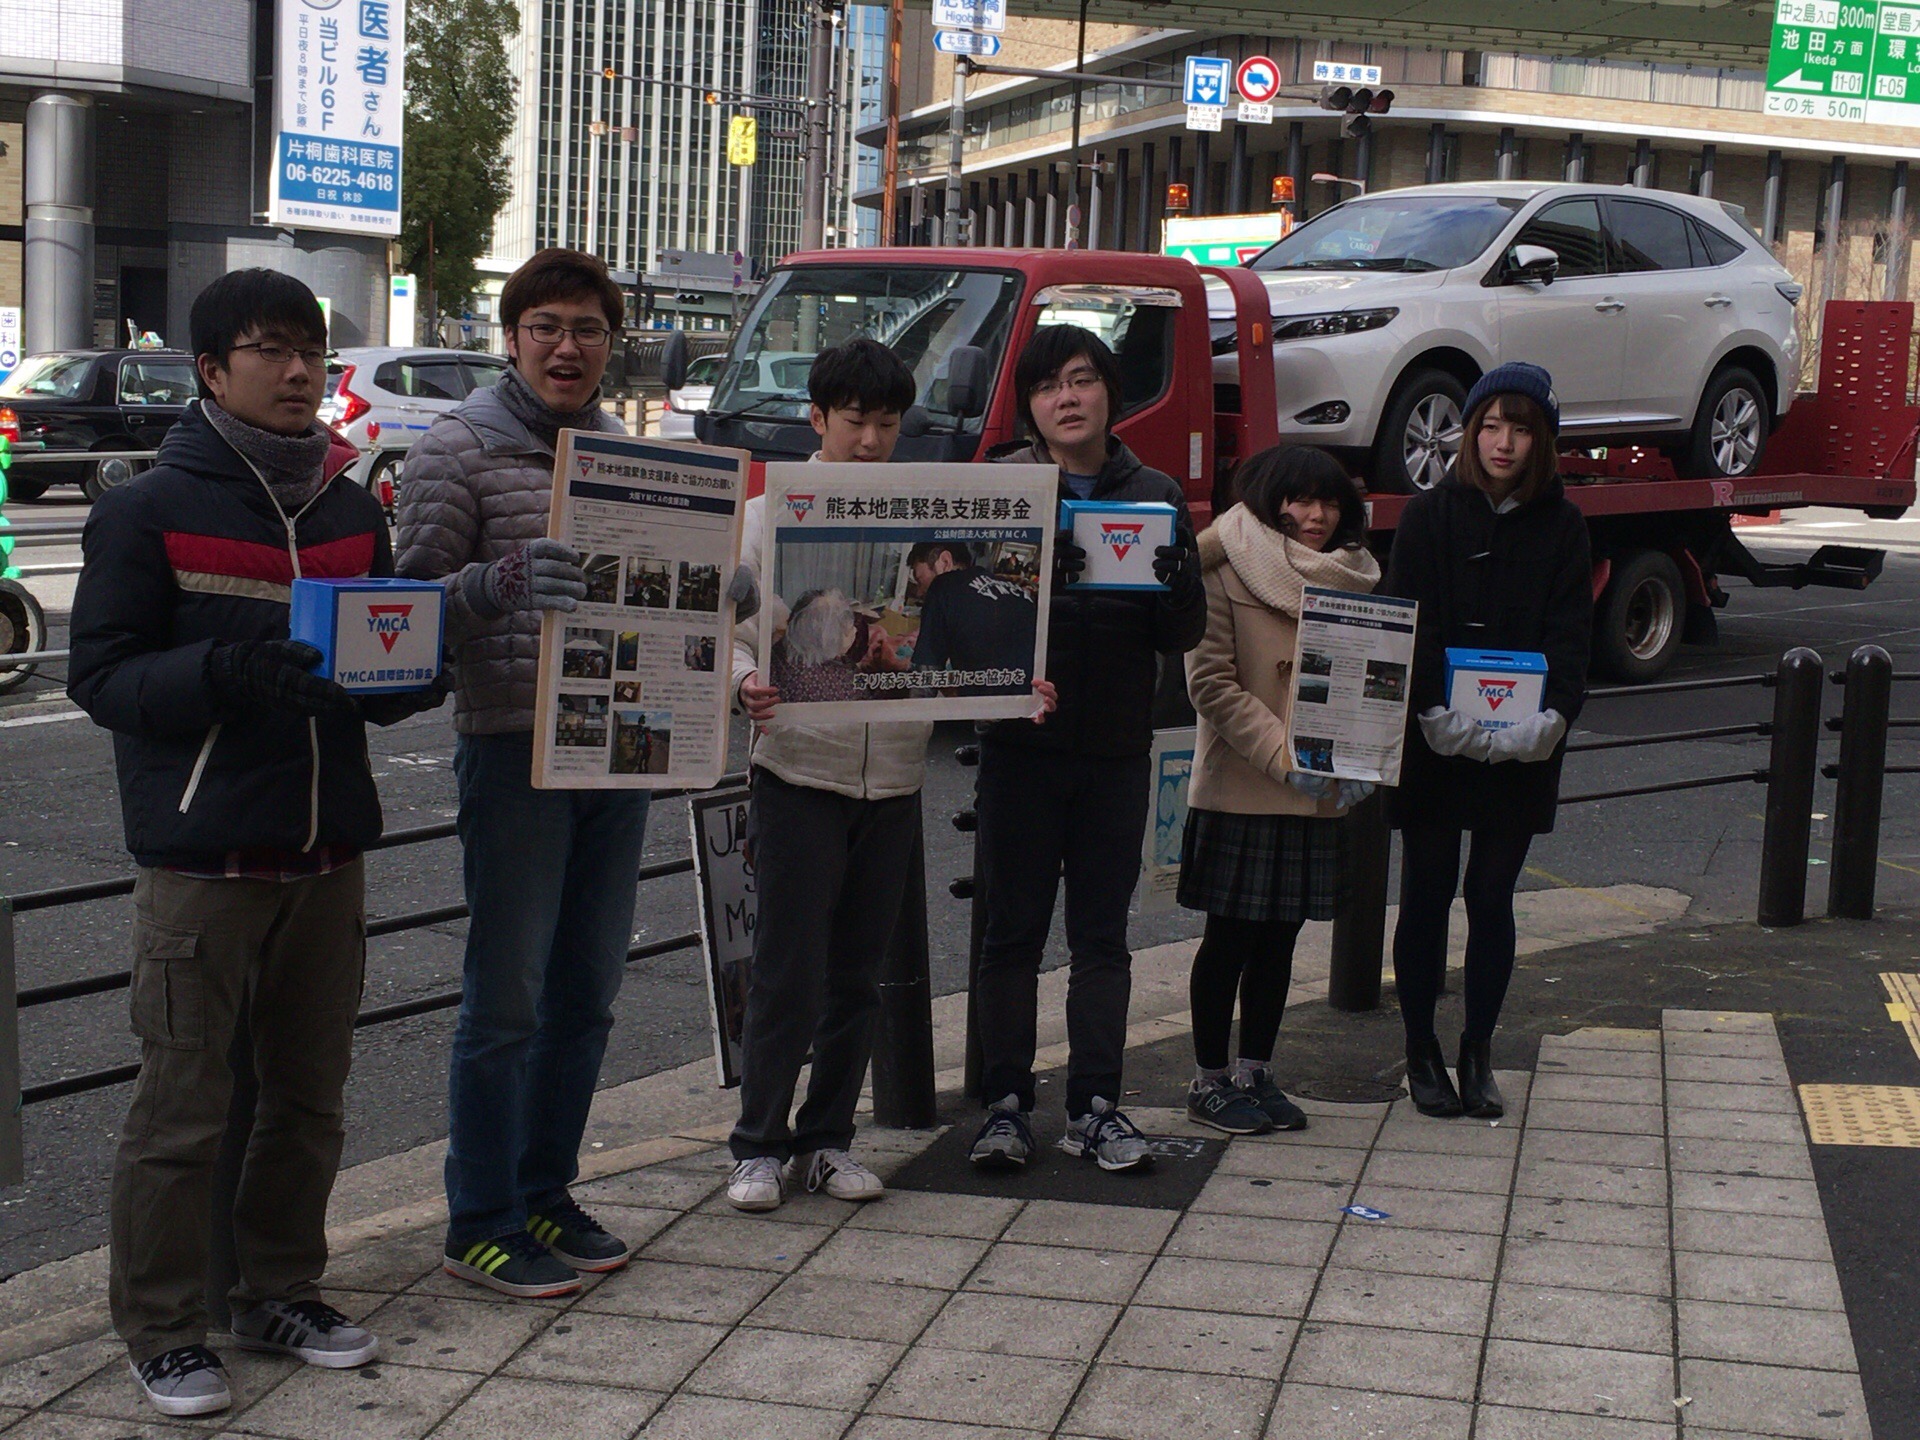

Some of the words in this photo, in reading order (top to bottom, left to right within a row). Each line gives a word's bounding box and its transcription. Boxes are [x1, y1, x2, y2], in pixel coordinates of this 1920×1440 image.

[945, 10, 992, 25] Higobashi
[1779, 1, 1837, 25] 中之島入口
[1839, 7, 1875, 30] 300m
[355, 0, 391, 138] 医者さん
[1804, 52, 1837, 67] Ikeda
[296, 13, 309, 129] 平日夜8時まで診療
[318, 16, 339, 132] 当ビル6F
[1316, 64, 1379, 82] 時差信号
[1834, 73, 1862, 92] 11-01
[1878, 77, 1905, 96] 1-05
[1768, 96, 1815, 114] この先
[1828, 100, 1862, 119] 50m
[287, 139, 394, 171] 片桐歯科医院
[286, 163, 394, 193] 06-6225-4618
[317, 189, 338, 201] 日祝
[343, 191, 364, 204] 休診
[681, 474, 735, 490] ご協力のお願い
[1710, 481, 1734, 506] R
[785, 501, 814, 512] YMCA
[825, 496, 1032, 521] 熊本地震緊急支援募金
[934, 529, 1029, 540] 公益財団法人大阪YMCA
[1100, 532, 1141, 545] YMCA
[366, 617, 411, 632] YMCA
[338, 668, 433, 684] YMCA国際協力募金
[853, 668, 1026, 691] 寄り添う支援活動にご協力を
[1477, 687, 1514, 699] YMCA
[709, 804, 748, 858] JA
[725, 898, 756, 943] Mo
